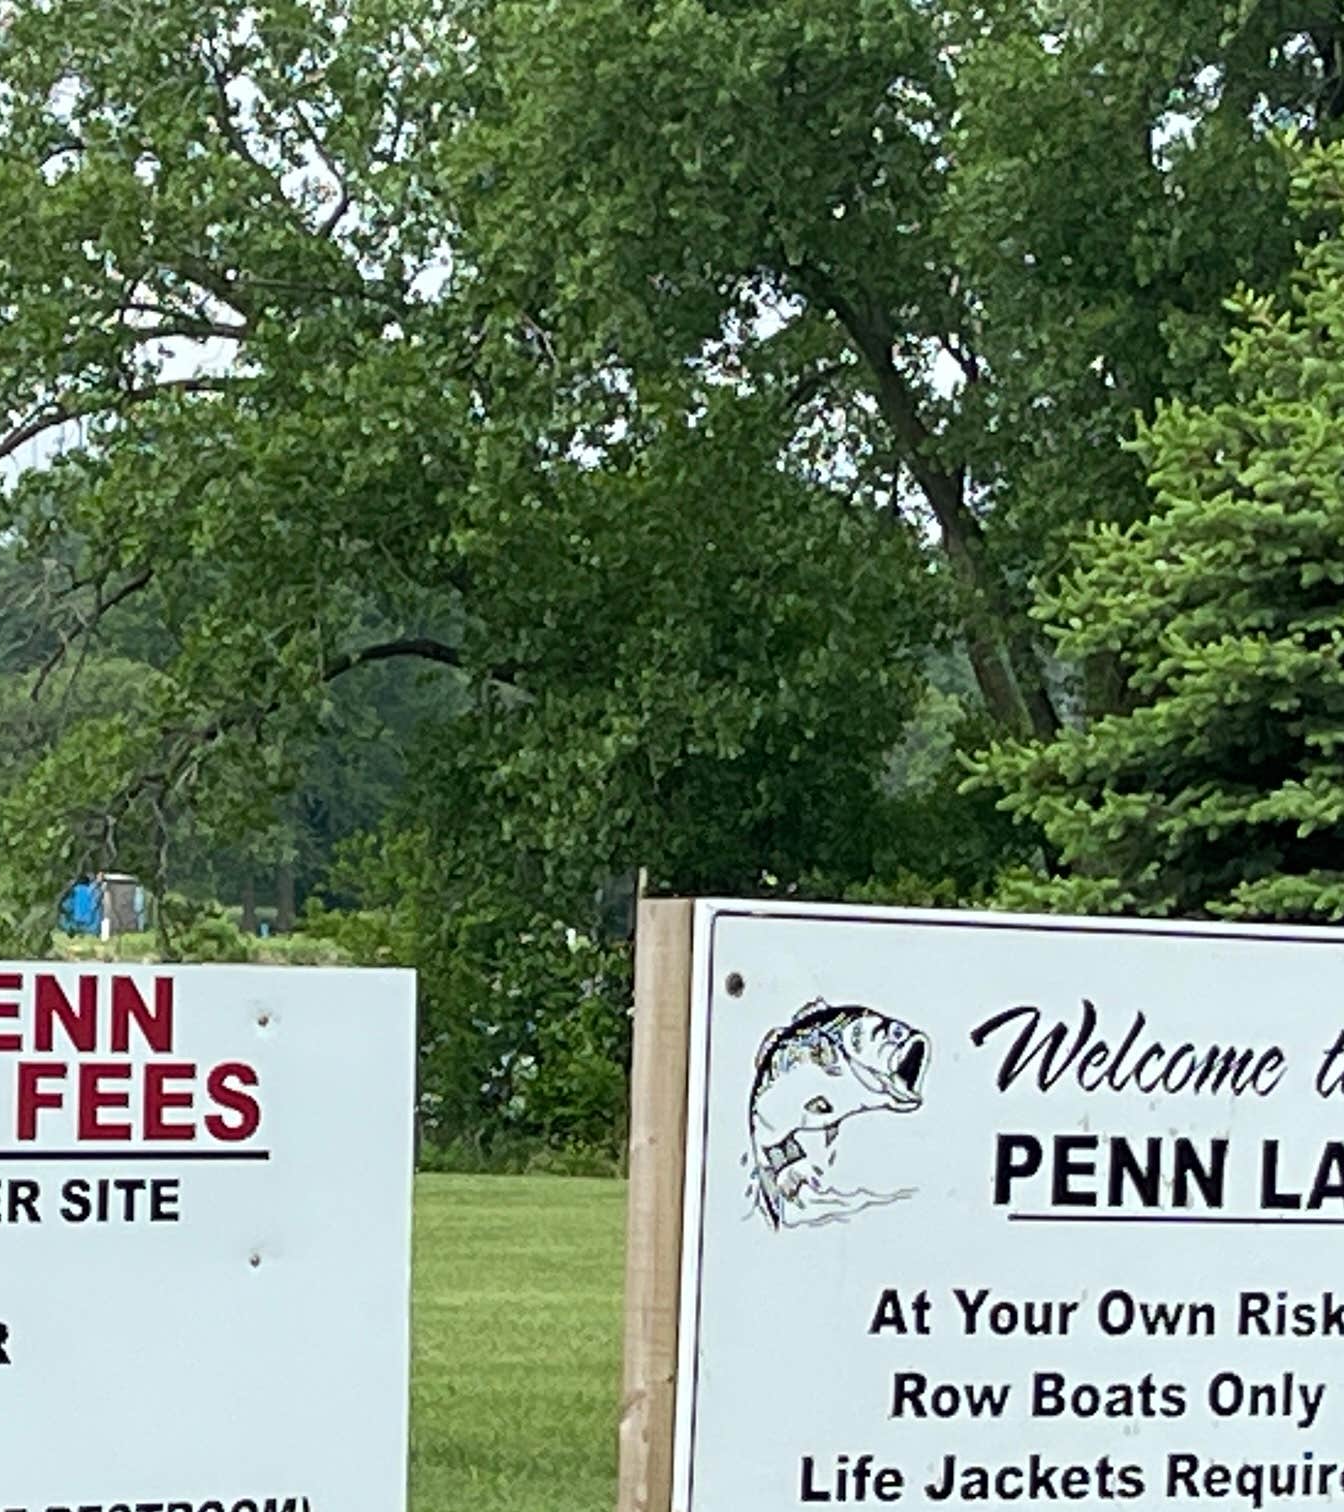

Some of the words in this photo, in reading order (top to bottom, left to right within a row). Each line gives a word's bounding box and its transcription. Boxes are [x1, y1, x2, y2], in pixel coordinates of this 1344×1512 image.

[969, 999, 1285, 1097] Welcome
[17, 1061, 262, 1142] FEES
[993, 1133, 1230, 1209] PENN
[59, 1178, 180, 1223] SITE
[868, 1289, 932, 1336] At
[953, 1289, 1080, 1336] Your
[1098, 1289, 1216, 1336] Own
[891, 1372, 1012, 1419] Row
[1031, 1372, 1186, 1418] Boats
[1208, 1372, 1326, 1429] Only
[800, 1454, 904, 1502] Life
[924, 1454, 1146, 1501] Jackets
